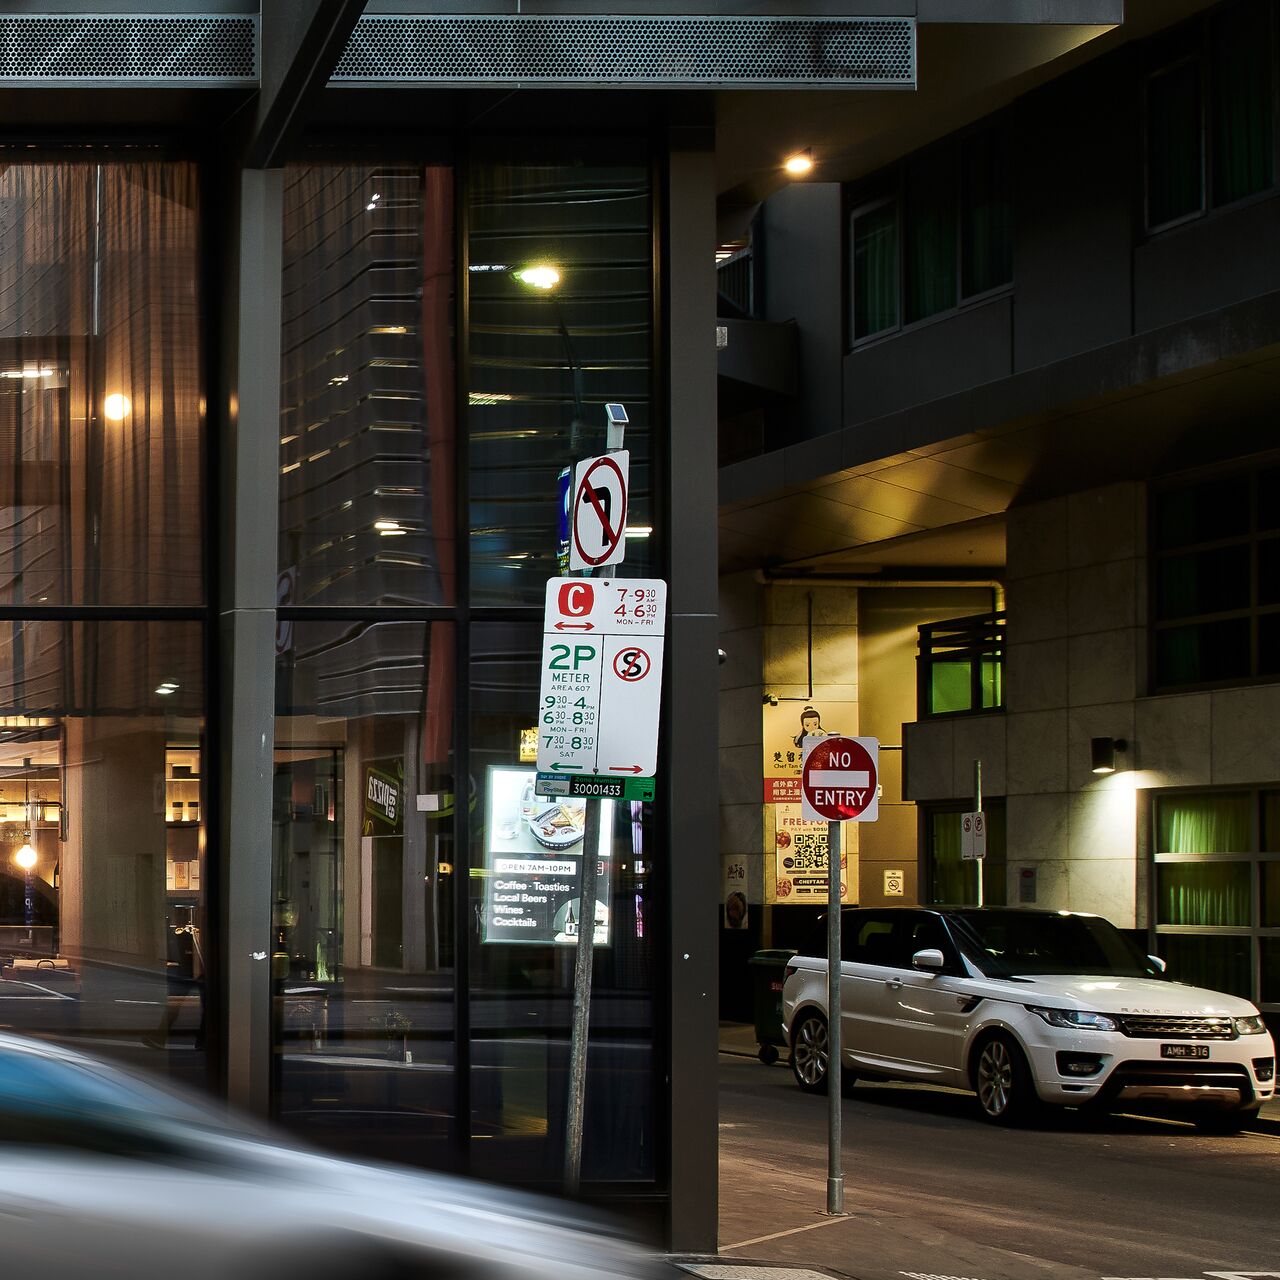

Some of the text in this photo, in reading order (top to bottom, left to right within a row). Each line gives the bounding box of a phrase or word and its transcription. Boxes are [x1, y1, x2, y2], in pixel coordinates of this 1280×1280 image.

[548, 644, 596, 670] 2P
[552, 673, 590, 683] METER
[829, 752, 851, 768] NO
[573, 784, 621, 796] 30001433
[815, 790, 867, 806] ENTRY
[495, 881, 527, 890] Coffee
[534, 882, 570, 891] Toasties
[494, 893, 520, 902] Local
[521, 893, 547, 903] Beers
[493, 904, 524, 914] Wines
[493, 917, 537, 927] Cocktails
